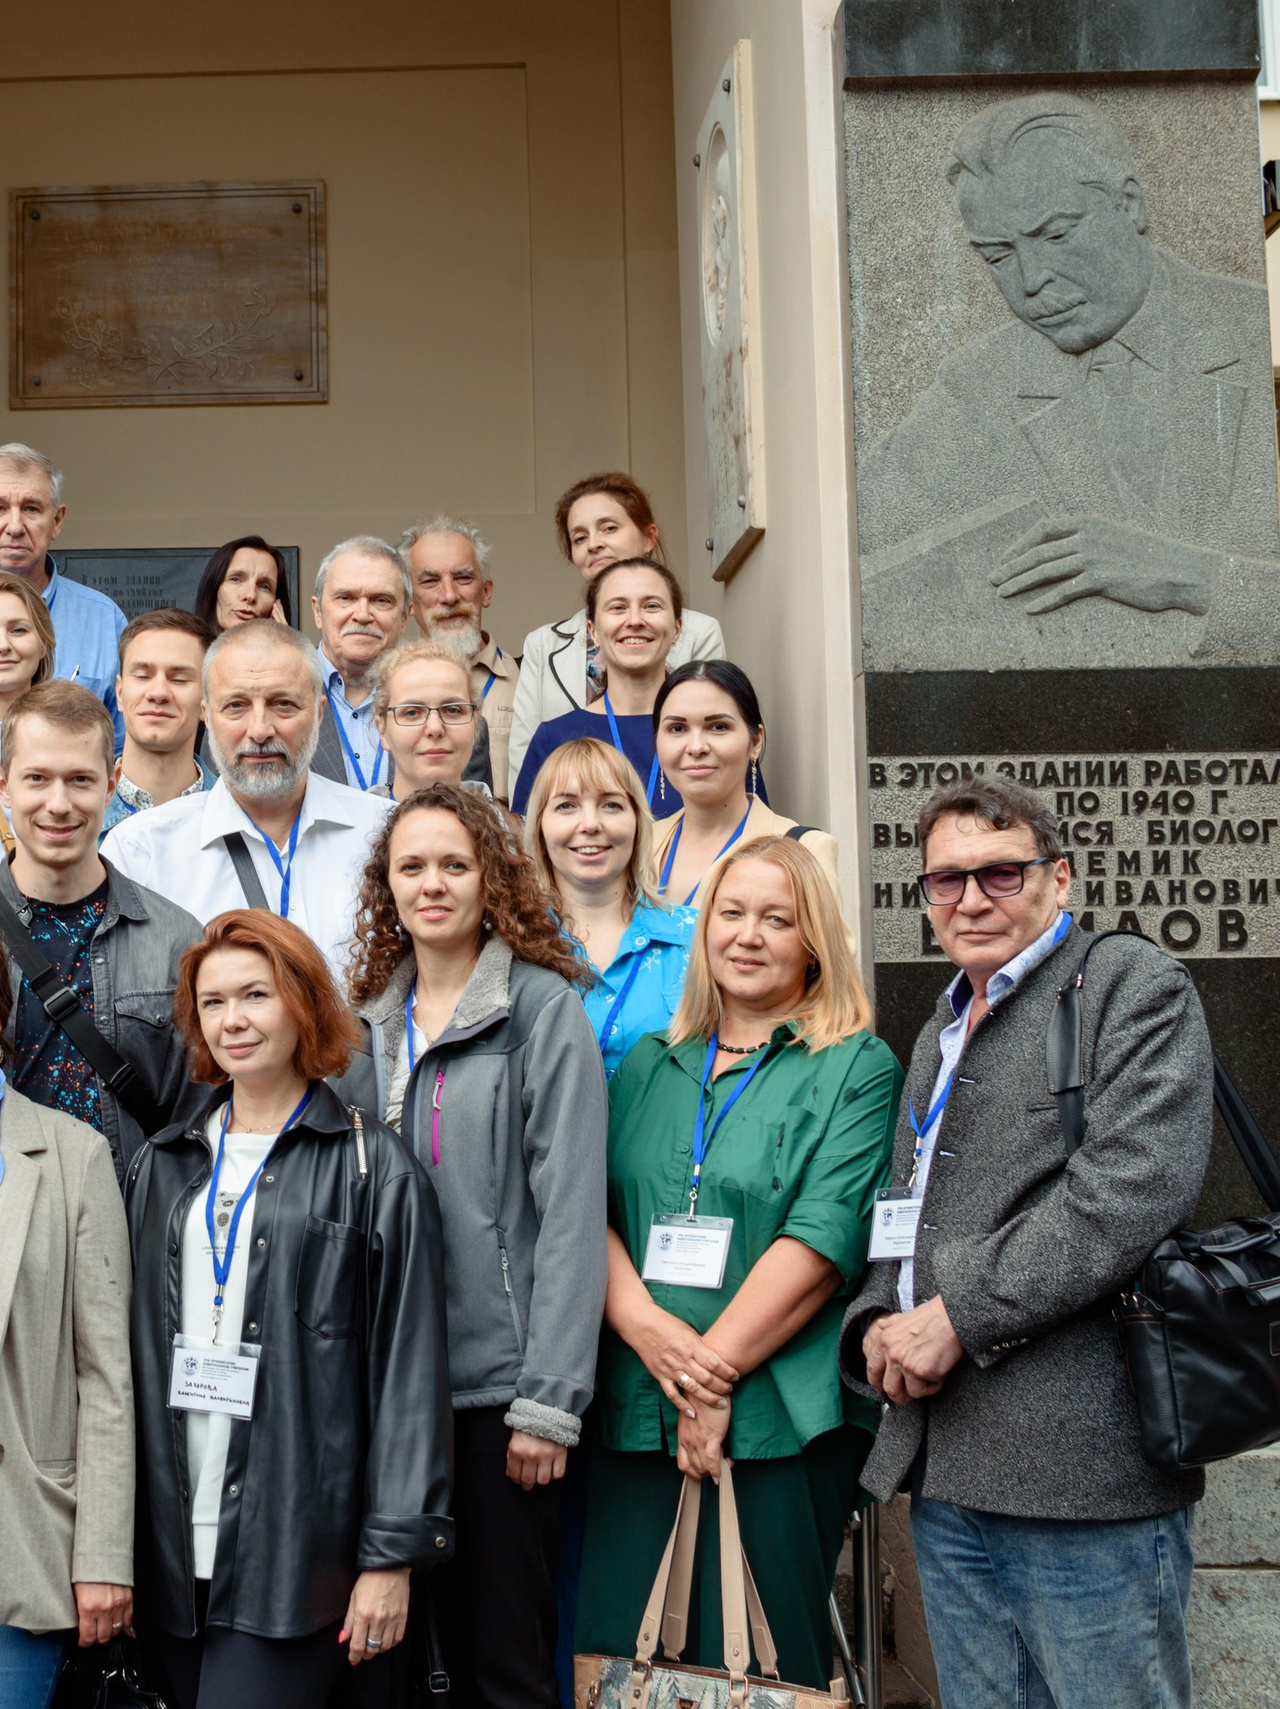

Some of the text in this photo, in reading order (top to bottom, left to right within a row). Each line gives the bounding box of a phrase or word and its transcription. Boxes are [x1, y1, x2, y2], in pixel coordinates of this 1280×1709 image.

[870, 763, 887, 788] В
[896, 762, 985, 788] ЭТОМ
[996, 760, 1128, 788] ЗДАНИИ
[1056, 789, 1228, 817] ПО 1940 Г
[1147, 819, 1278, 846] БИОЛОГ
